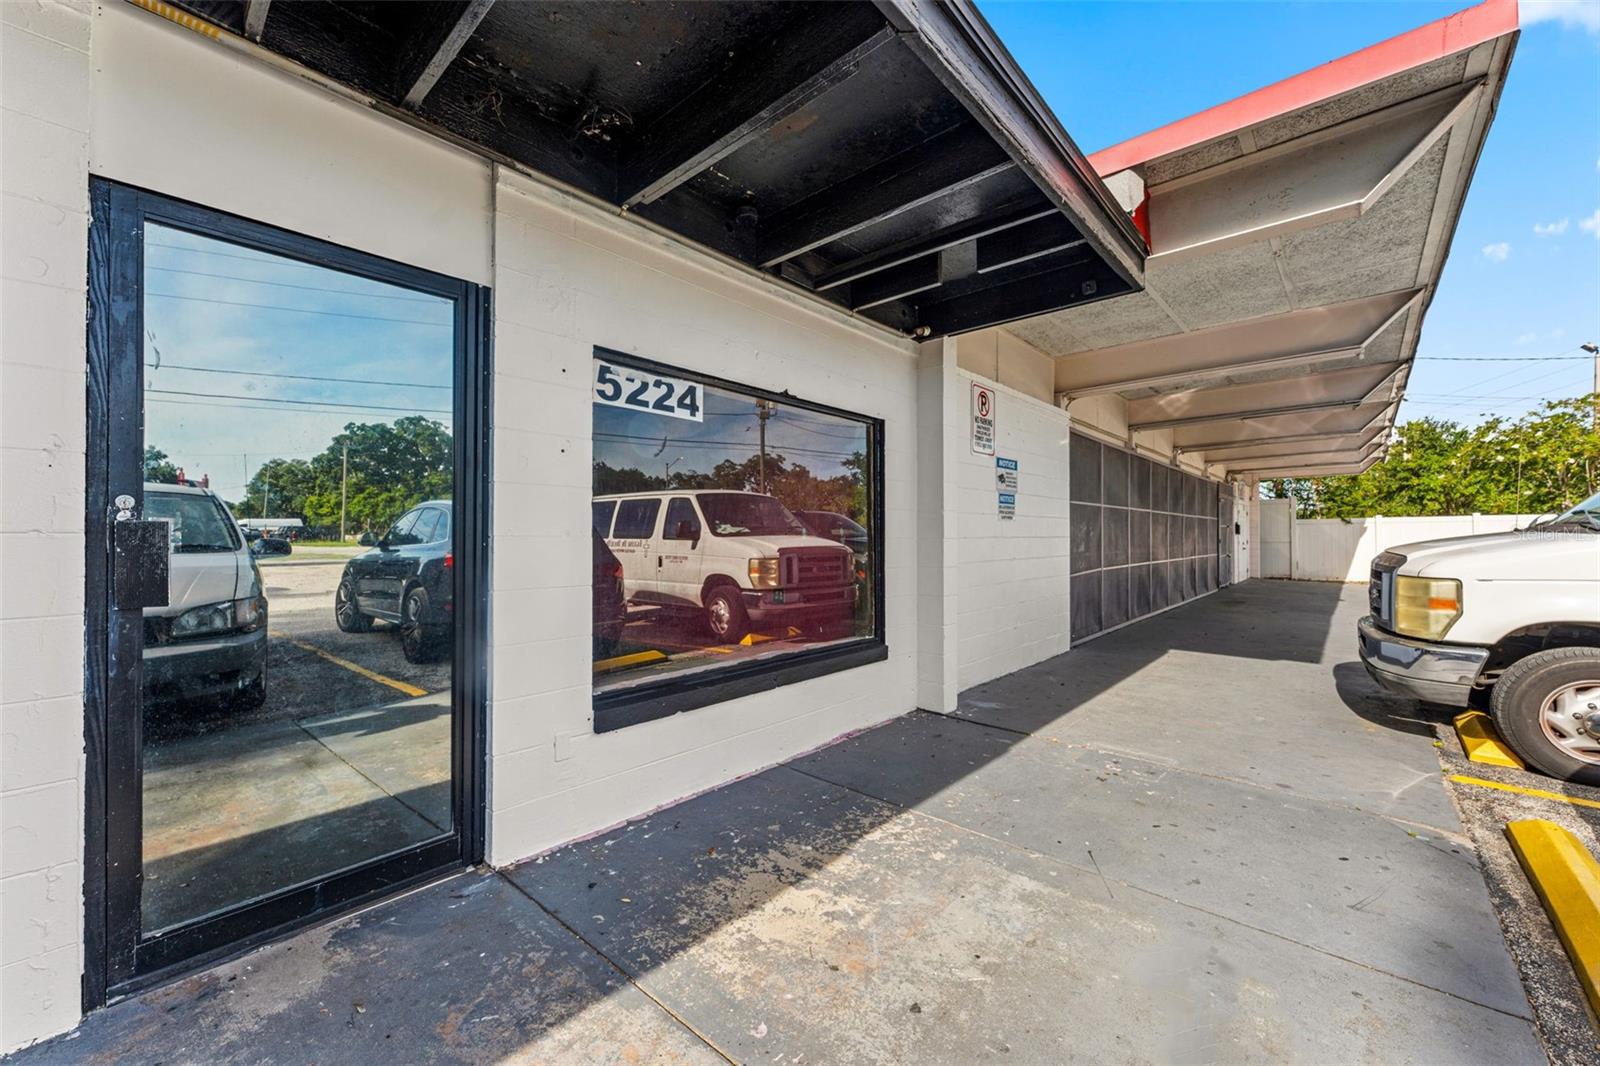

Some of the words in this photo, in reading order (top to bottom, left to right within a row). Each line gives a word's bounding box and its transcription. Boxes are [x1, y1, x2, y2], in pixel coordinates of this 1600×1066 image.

[596, 364, 699, 417] 5224
[998, 459, 1016, 469] NOTICE
[999, 495, 1014, 503] NOTICE
